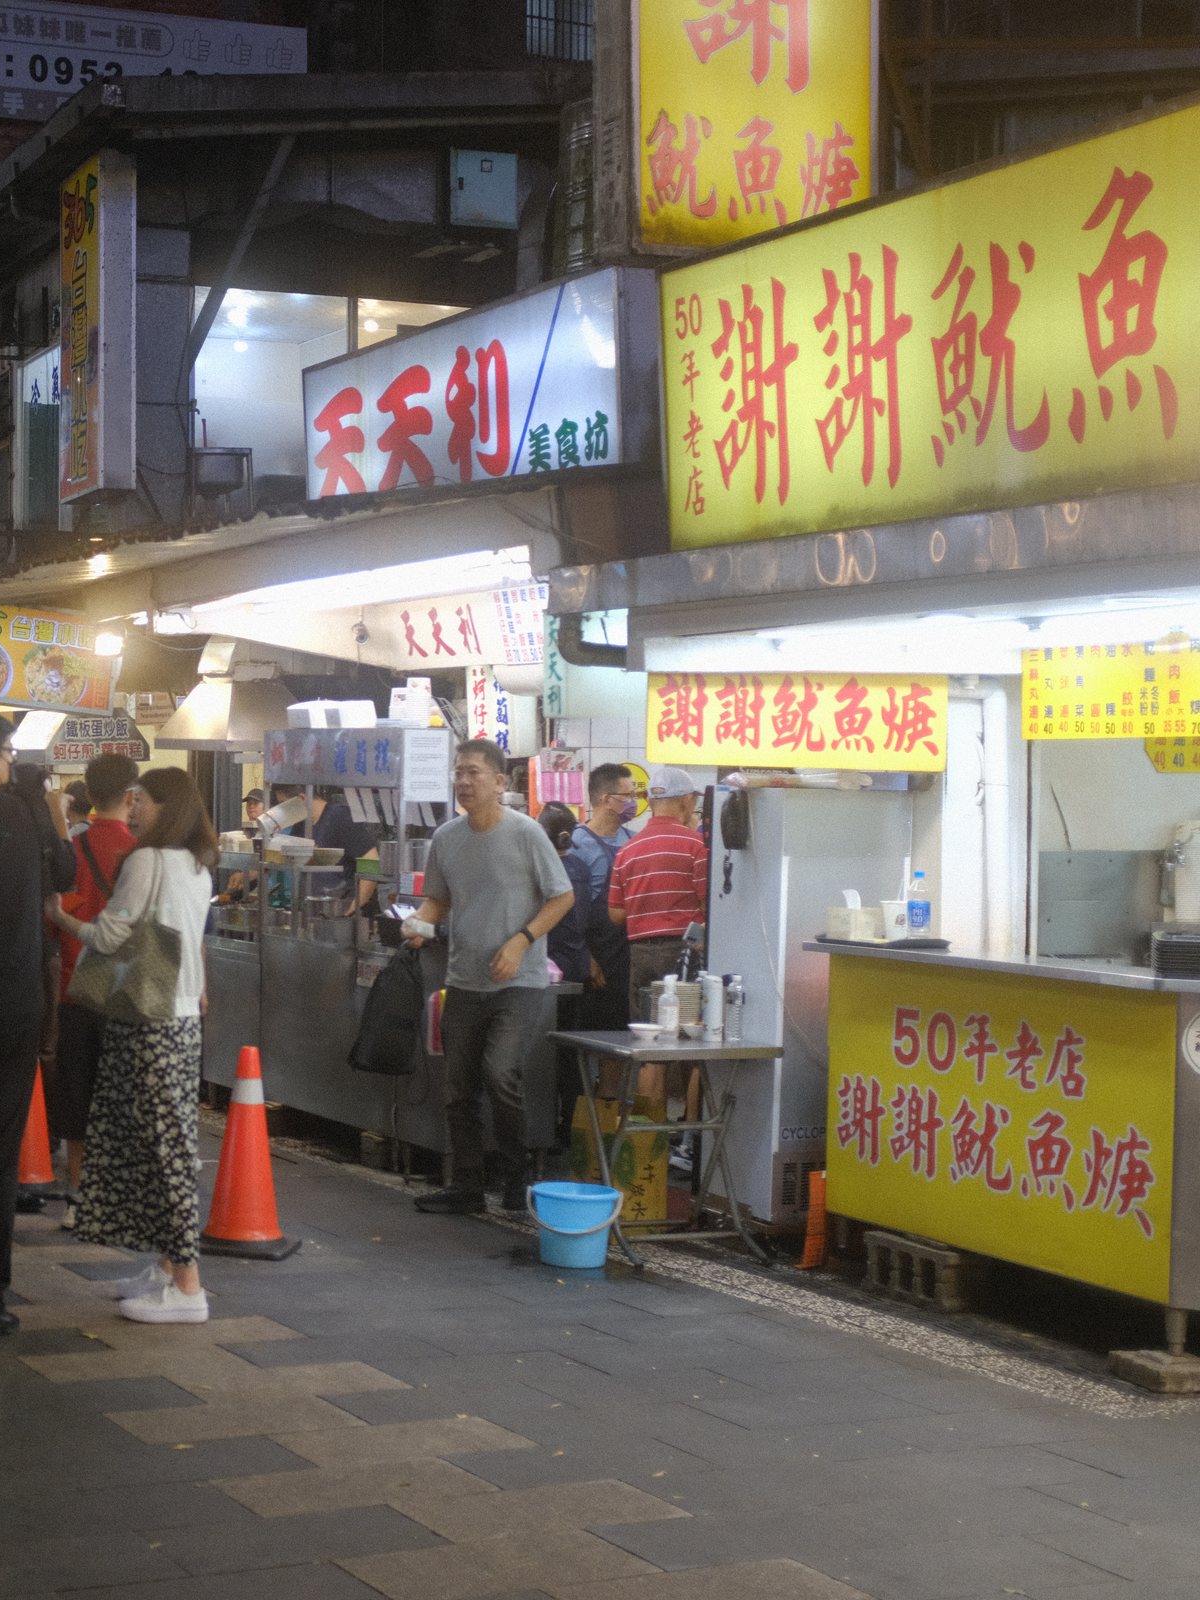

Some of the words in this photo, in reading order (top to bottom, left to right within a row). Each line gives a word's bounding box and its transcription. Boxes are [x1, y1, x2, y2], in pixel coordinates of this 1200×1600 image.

[313, 338, 511, 499] 天天利
[673, 291, 706, 517] 50年老店
[528, 410, 609, 474] 美食坊
[400, 603, 483, 658] 天天利
[1044, 723, 1053, 735] 40
[1075, 721, 1084, 733] 50
[1105, 723, 1116, 734] 50
[1144, 722, 1155, 735] 50
[1173, 753, 1184, 767] 40
[893, 1007, 1086, 1099] 50年老店
